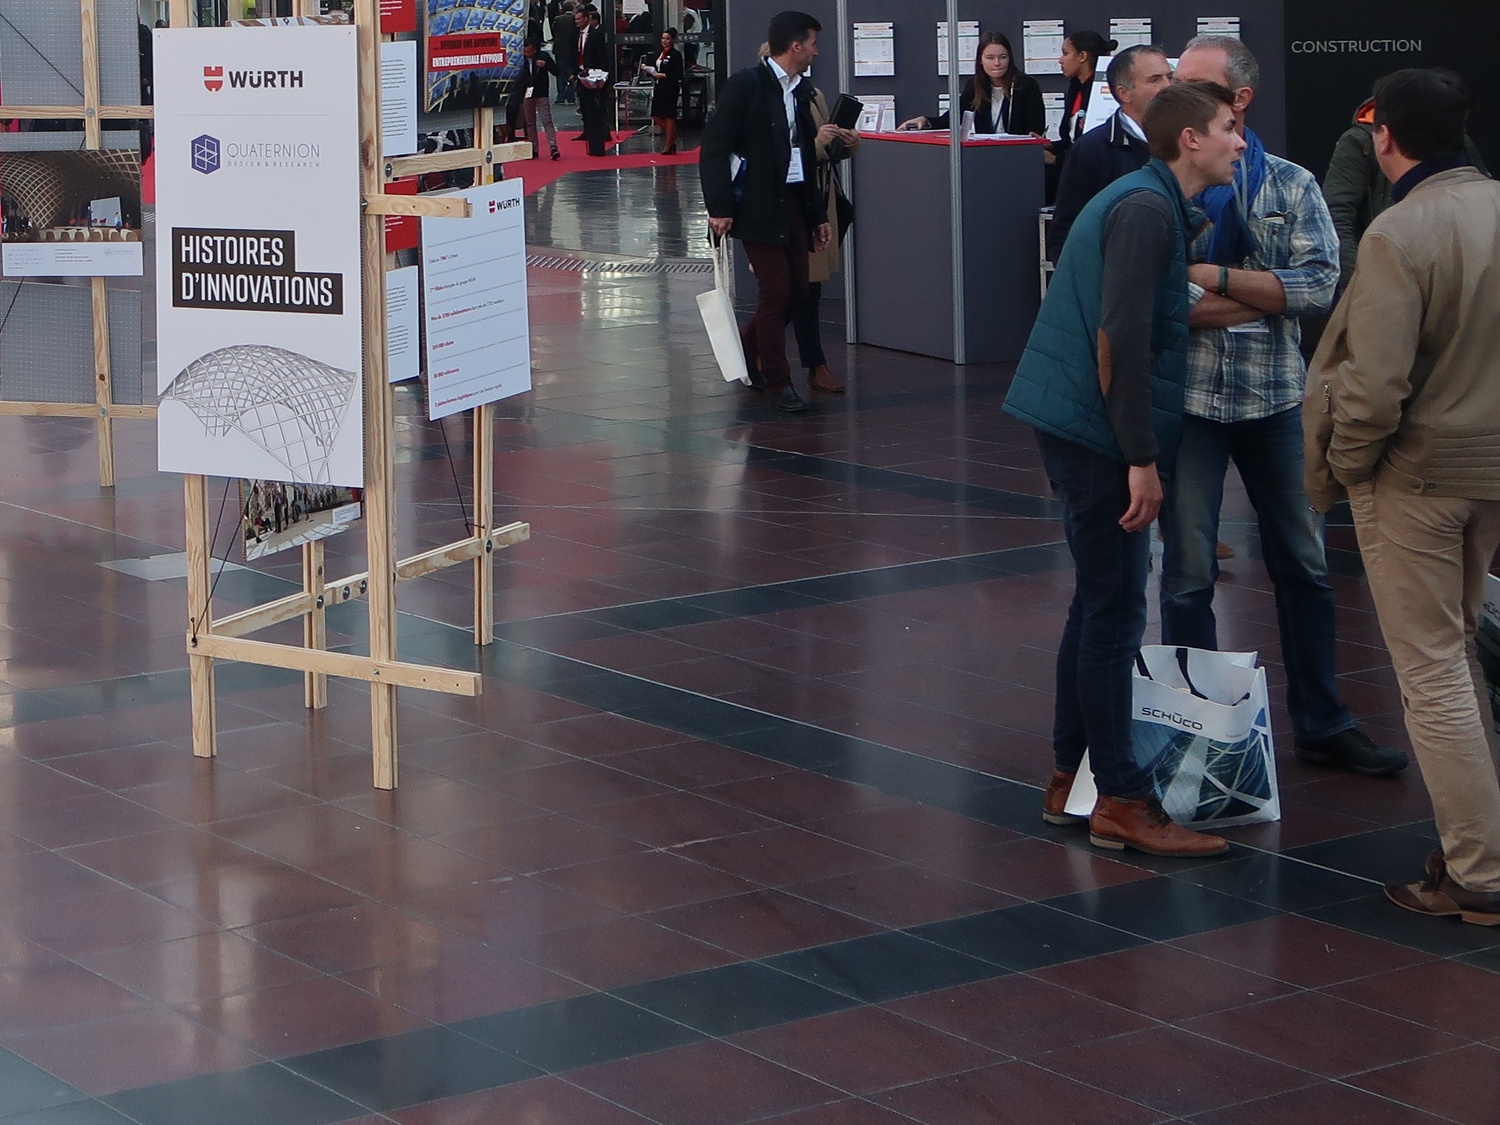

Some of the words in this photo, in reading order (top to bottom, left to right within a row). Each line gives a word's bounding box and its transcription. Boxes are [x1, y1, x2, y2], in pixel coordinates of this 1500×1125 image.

[1291, 40, 1421, 53] CONSTRUCTION
[228, 70, 303, 88] WÜRTH
[226, 142, 320, 159] QUATERNION
[497, 198, 520, 211] WÜRTH
[181, 235, 284, 266] HISTOIRES
[182, 272, 333, 306] D'INNOVATIONS
